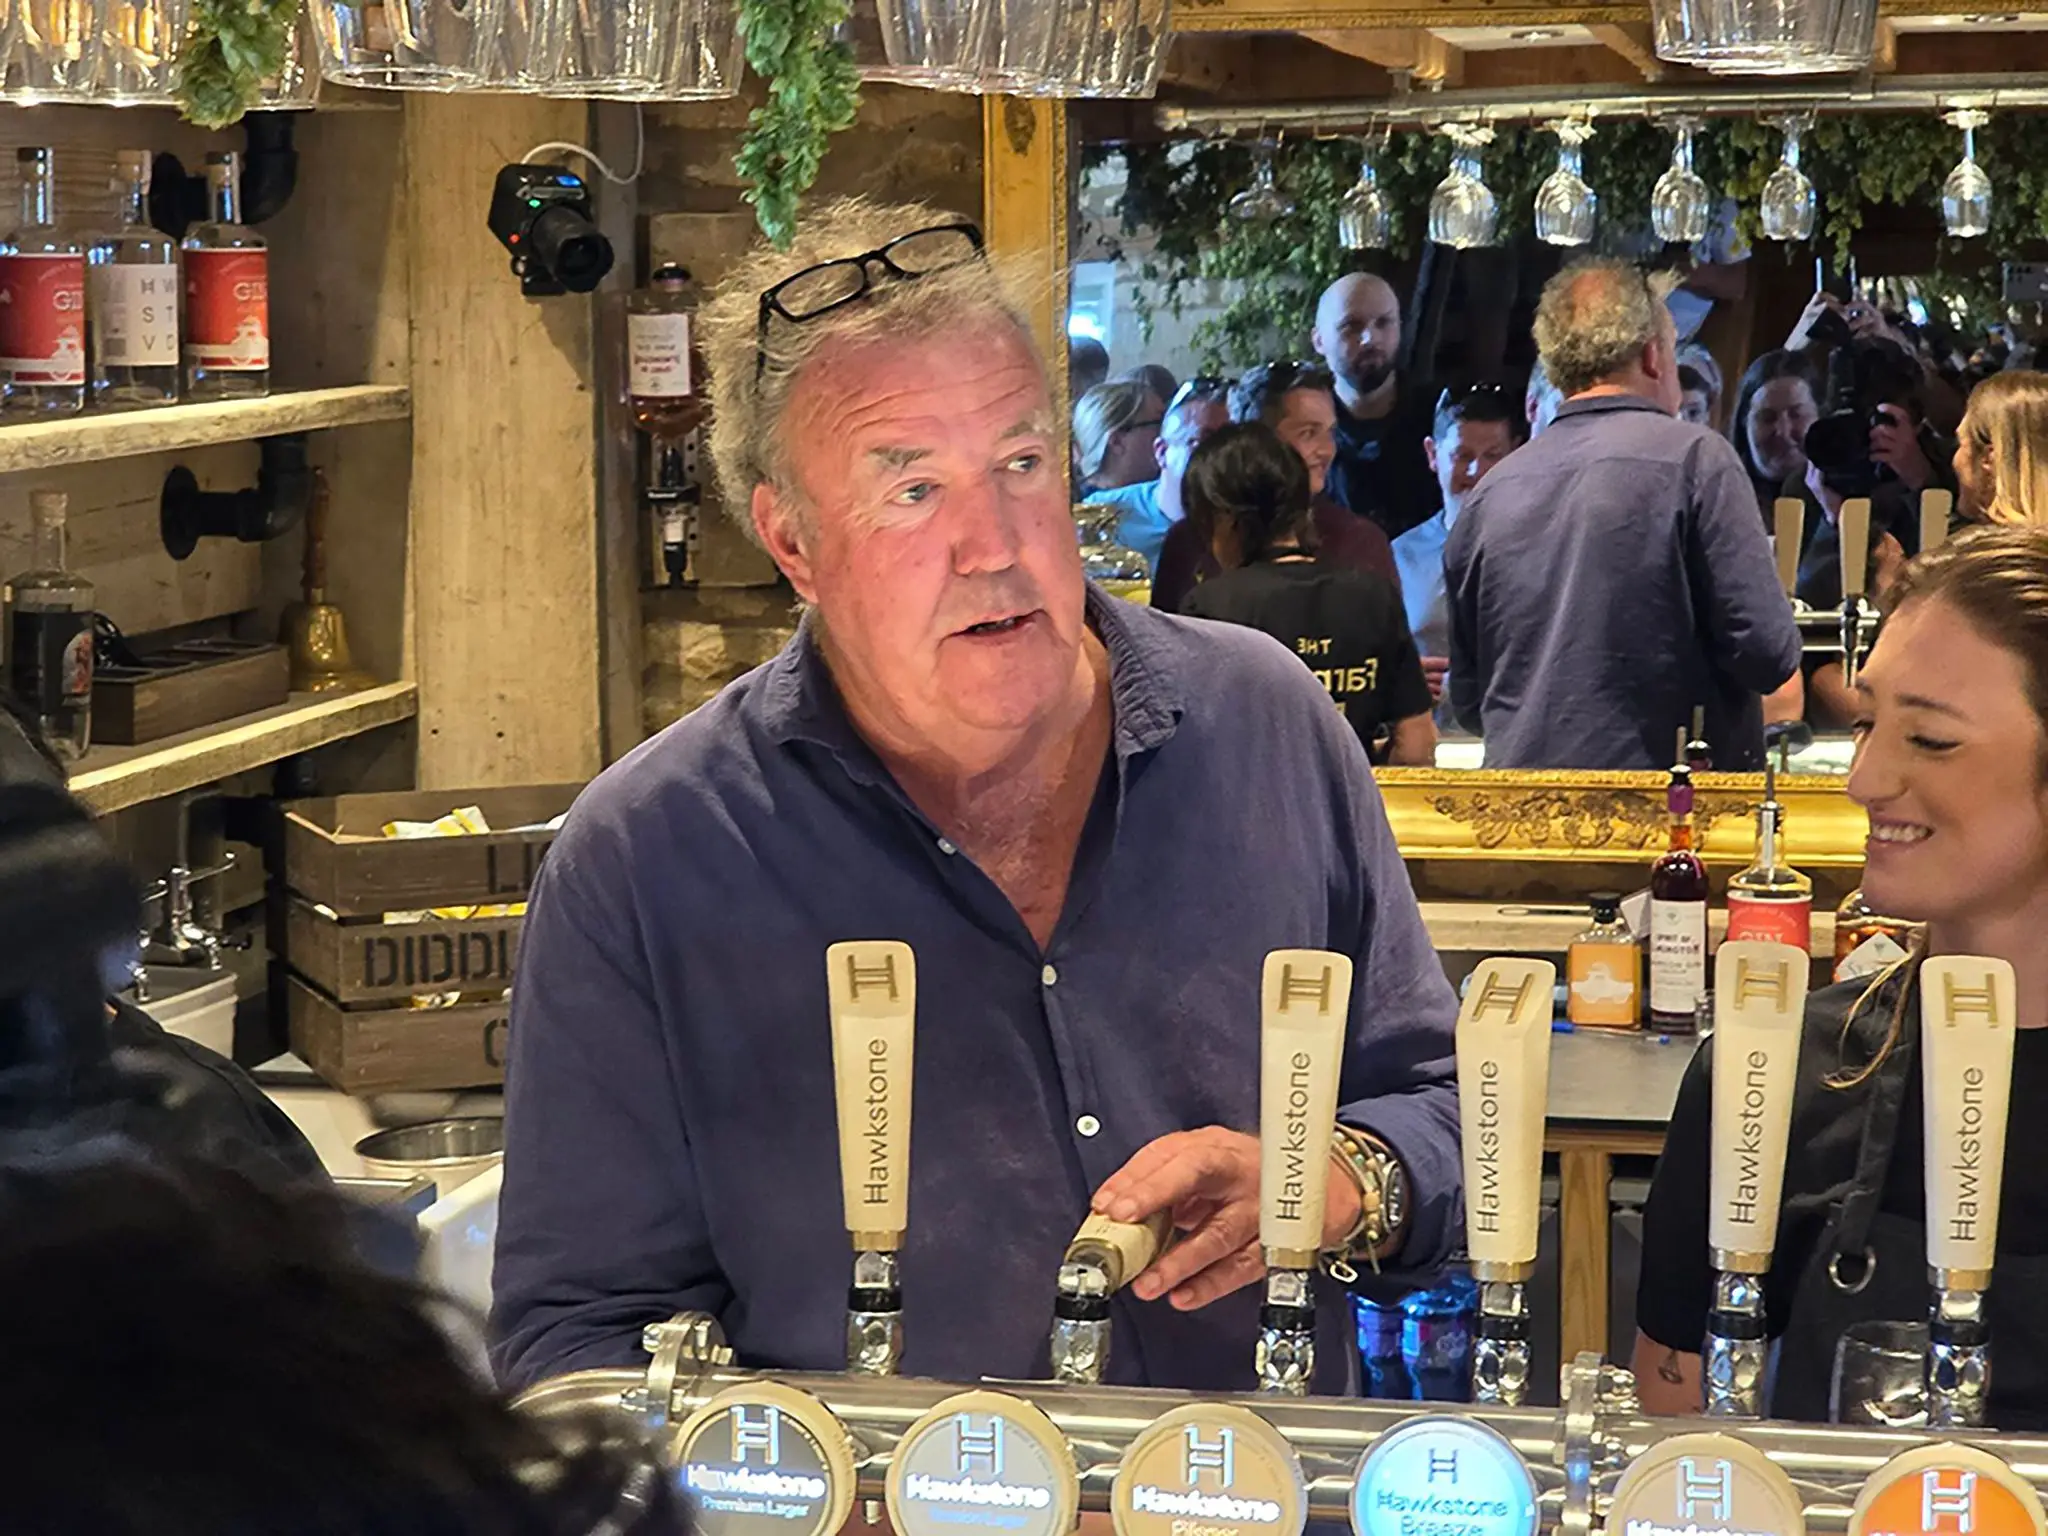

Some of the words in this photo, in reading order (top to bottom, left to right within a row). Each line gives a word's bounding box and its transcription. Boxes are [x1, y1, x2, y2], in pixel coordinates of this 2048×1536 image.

[863, 1038, 888, 1205] Hawkstone
[1275, 1051, 1311, 1221] Hawkstone
[1729, 1050, 1768, 1225] Hawkstone
[1476, 1060, 1499, 1234] Hawkstone
[1949, 1066, 1984, 1241] Hawkstone
[686, 1464, 826, 1498] Hawkstone
[906, 1473, 1051, 1509] Hawkstone
[702, 1496, 765, 1514] Premium
[1132, 1485, 1281, 1523] Hawkstone
[1376, 1489, 1509, 1517] Hawkstone
[1401, 1515, 1486, 1536] Breeze
